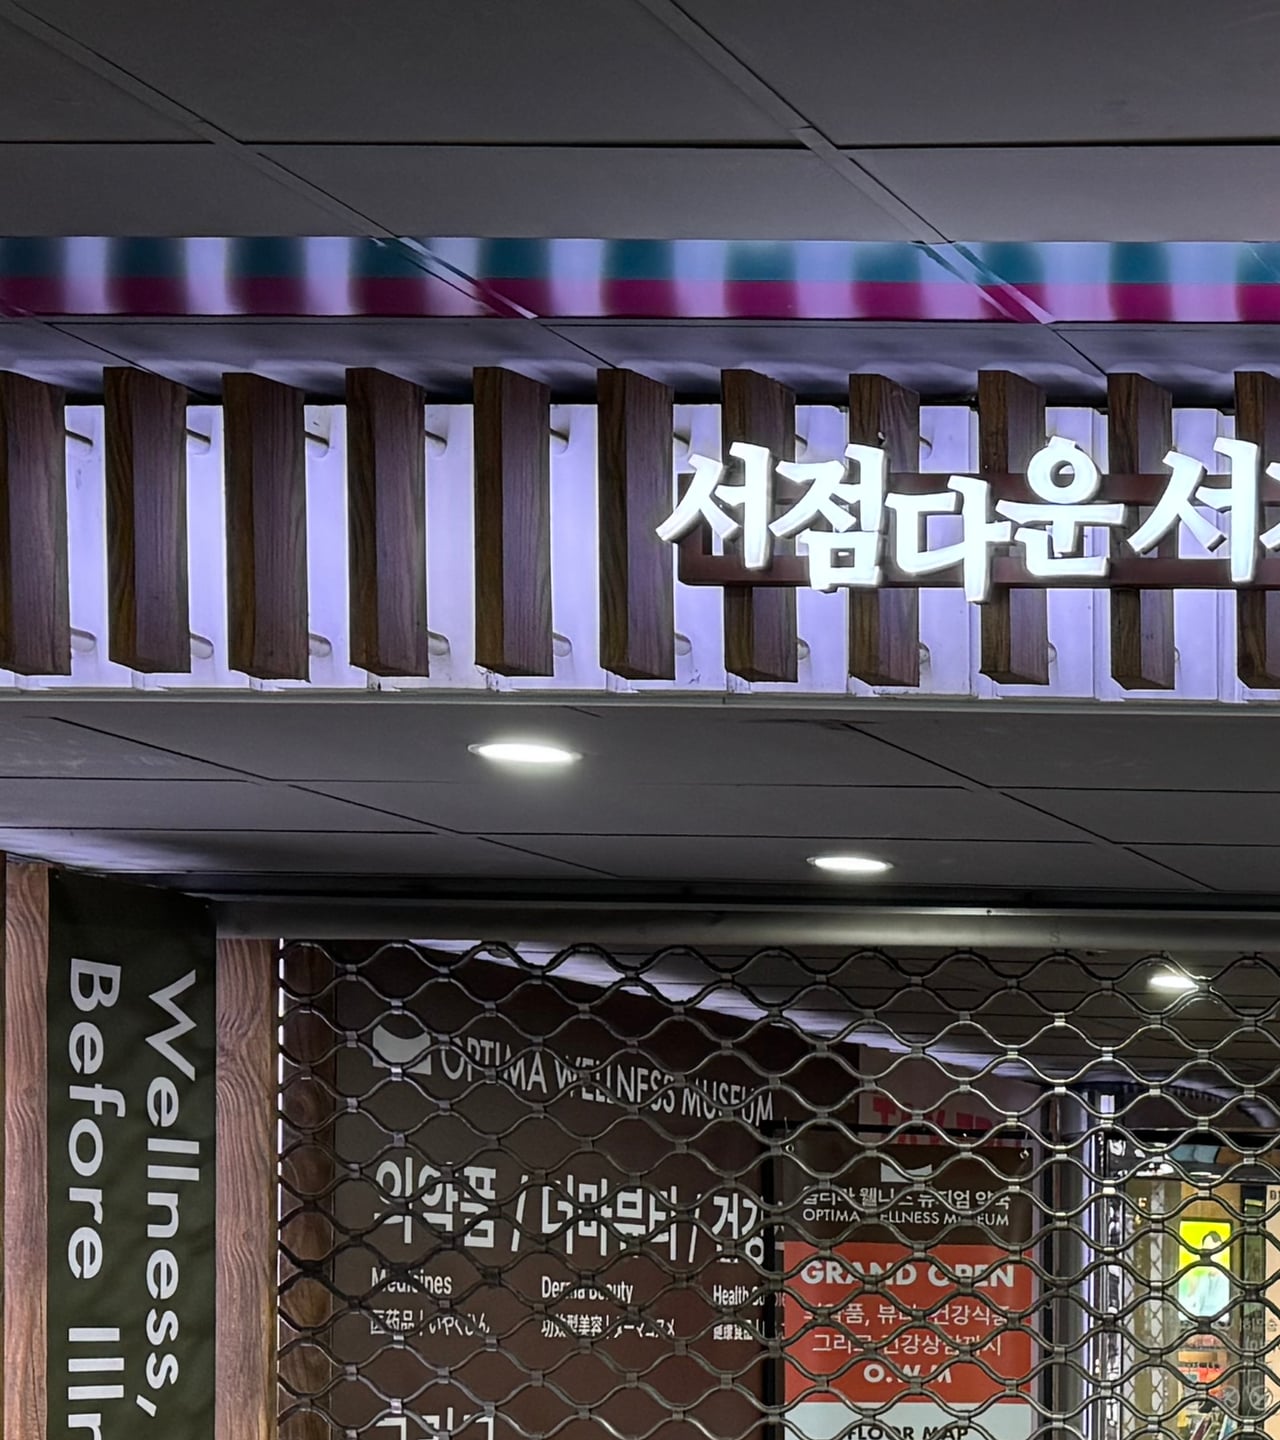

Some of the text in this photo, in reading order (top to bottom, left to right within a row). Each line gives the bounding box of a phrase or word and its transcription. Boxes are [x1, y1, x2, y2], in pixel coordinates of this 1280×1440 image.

[440, 1034, 548, 1095] OPTIMA
[67, 956, 126, 1281] Before
[802, 1208, 861, 1223] OPTIMA
[866, 1210, 940, 1225] ELLNESS
[800, 1260, 1015, 1288] GRAND OPEN
[847, 1425, 969, 1440] FLOOR MAP
